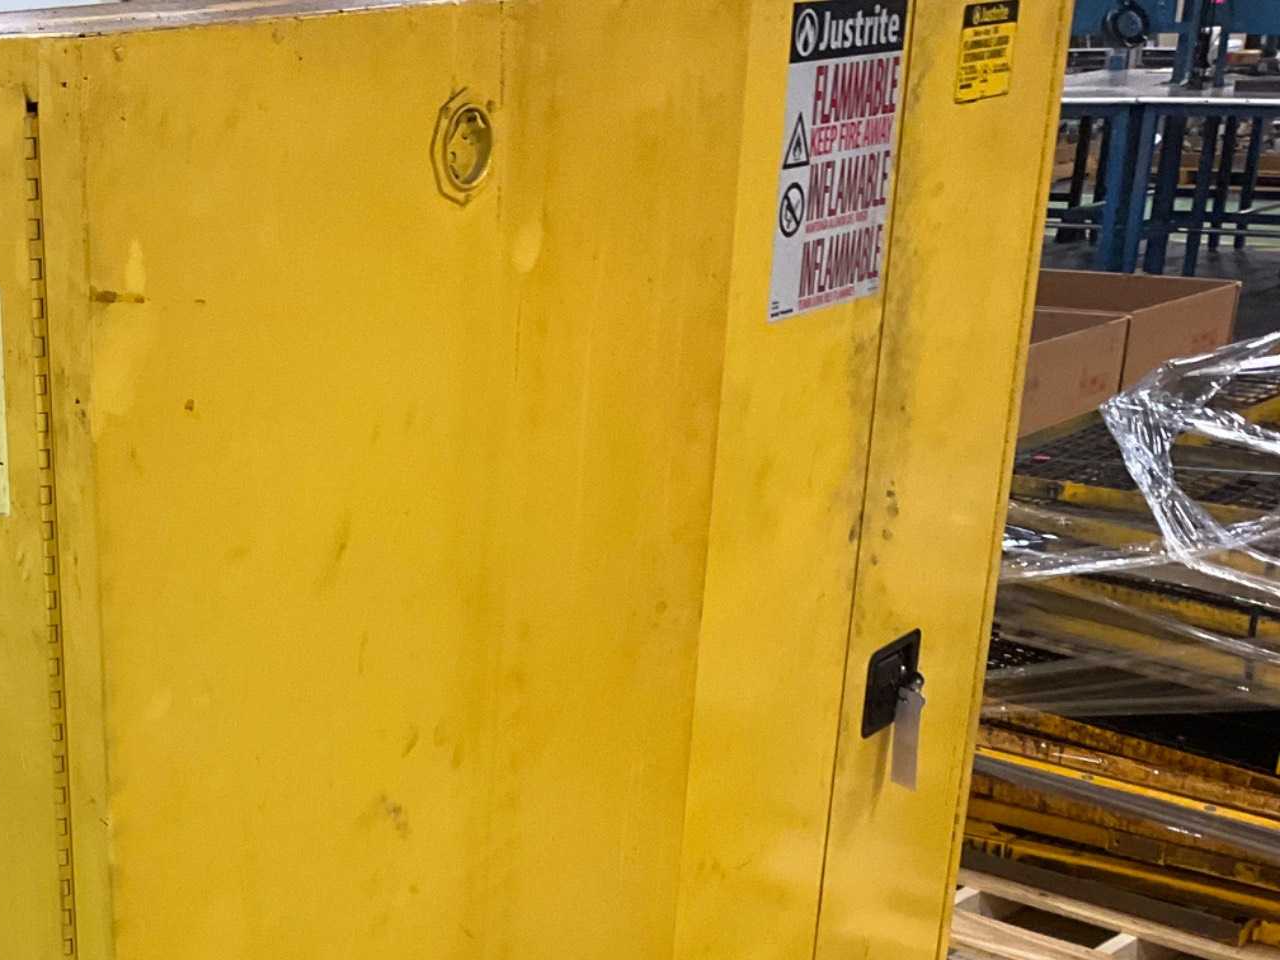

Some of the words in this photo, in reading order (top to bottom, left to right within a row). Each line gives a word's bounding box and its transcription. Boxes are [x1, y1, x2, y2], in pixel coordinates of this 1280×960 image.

[818, 4, 900, 51] Justrite
[812, 56, 900, 126] FLAMMABLE
[809, 125, 838, 157] KEEP
[838, 120, 861, 152] FIRE
[863, 114, 894, 148] AWAY
[807, 150, 891, 221] INFLAMABLE
[799, 224, 883, 298] INFLAMMABLE
